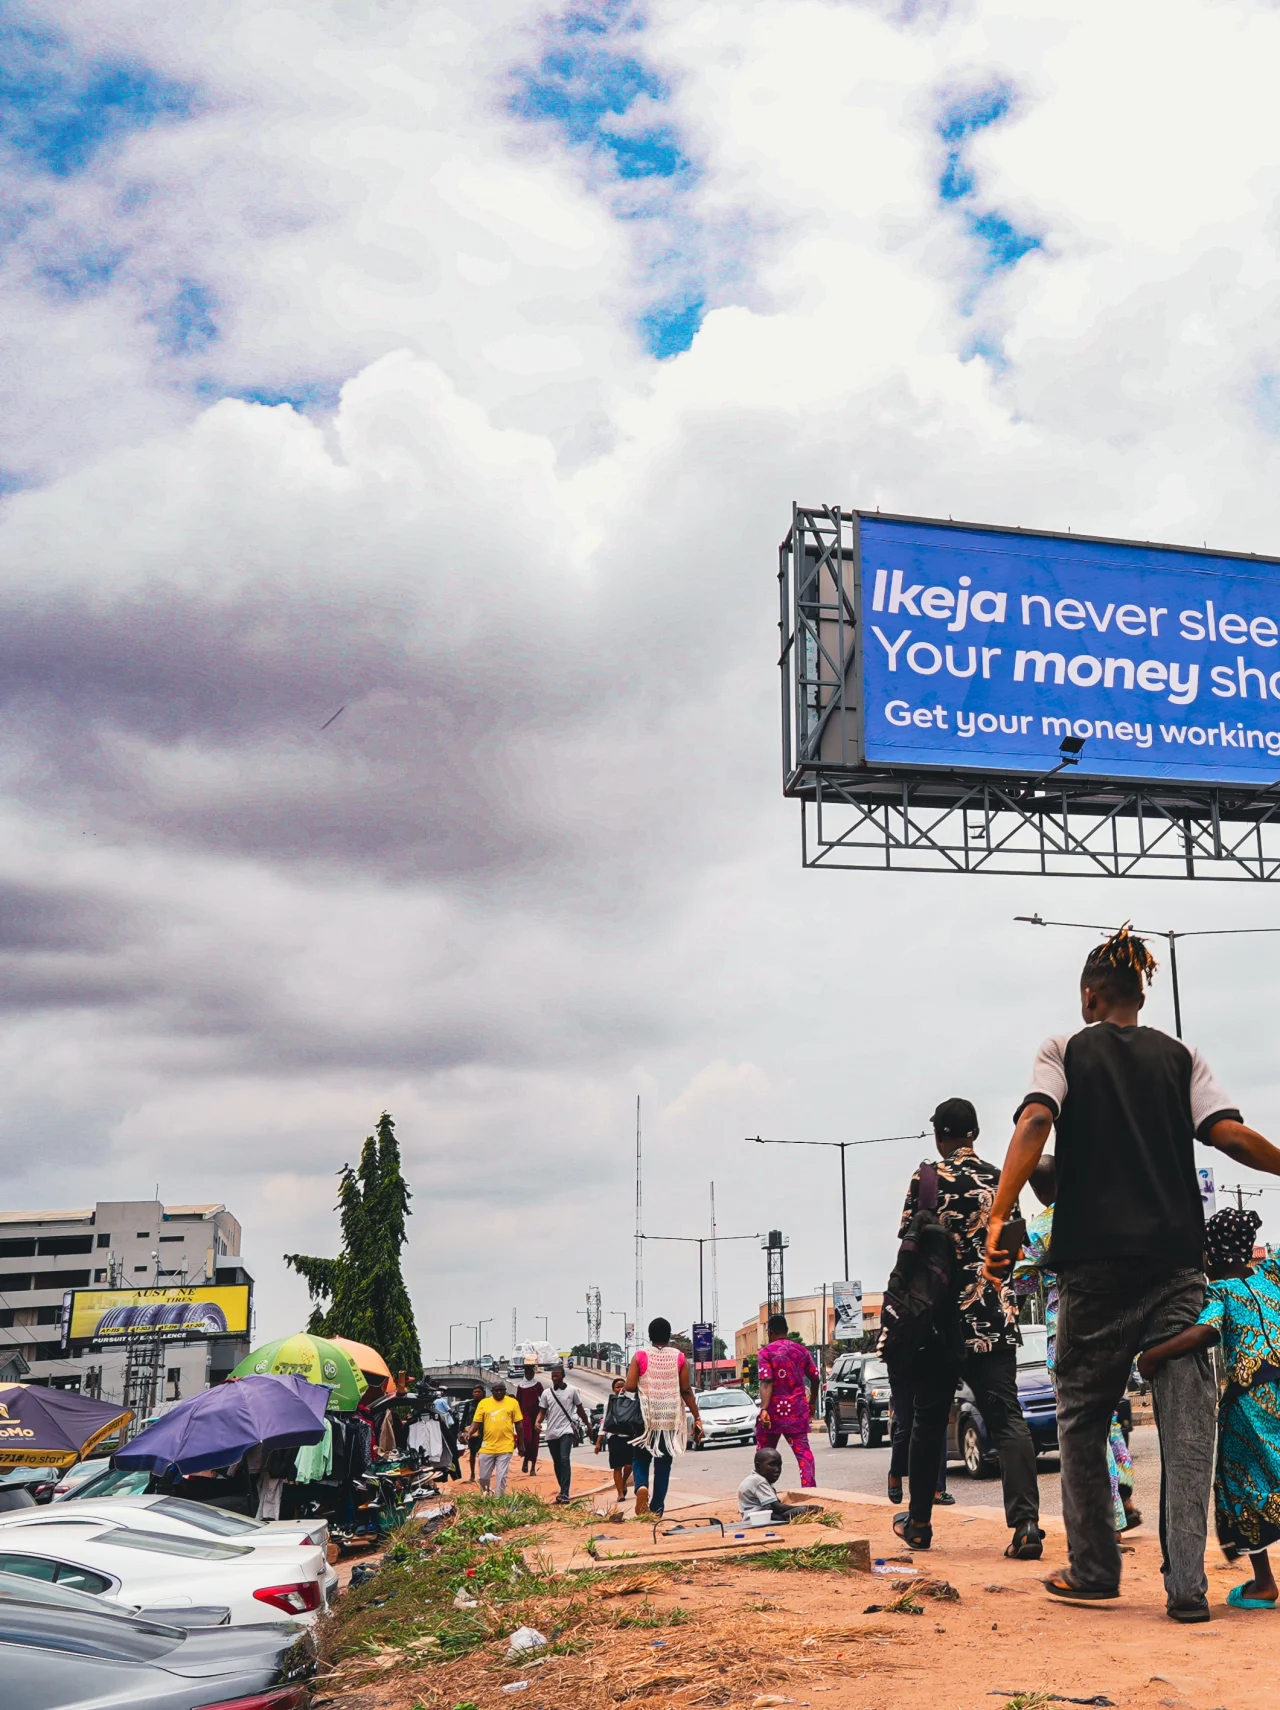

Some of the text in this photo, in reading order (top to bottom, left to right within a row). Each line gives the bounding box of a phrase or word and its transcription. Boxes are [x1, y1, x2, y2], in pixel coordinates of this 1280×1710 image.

[872, 568, 1008, 632] Ikeja
[1020, 594, 1167, 637] never
[871, 626, 1000, 680] Your
[1013, 648, 1199, 705] money
[885, 700, 949, 730] Get
[956, 709, 1033, 738] your
[1041, 715, 1153, 748] money
[92, 1336, 127, 1344] PURSUIT
[324, 1363, 337, 1377] glo
[25, 1454, 37, 1463] to
[39, 1455, 66, 1464] start
